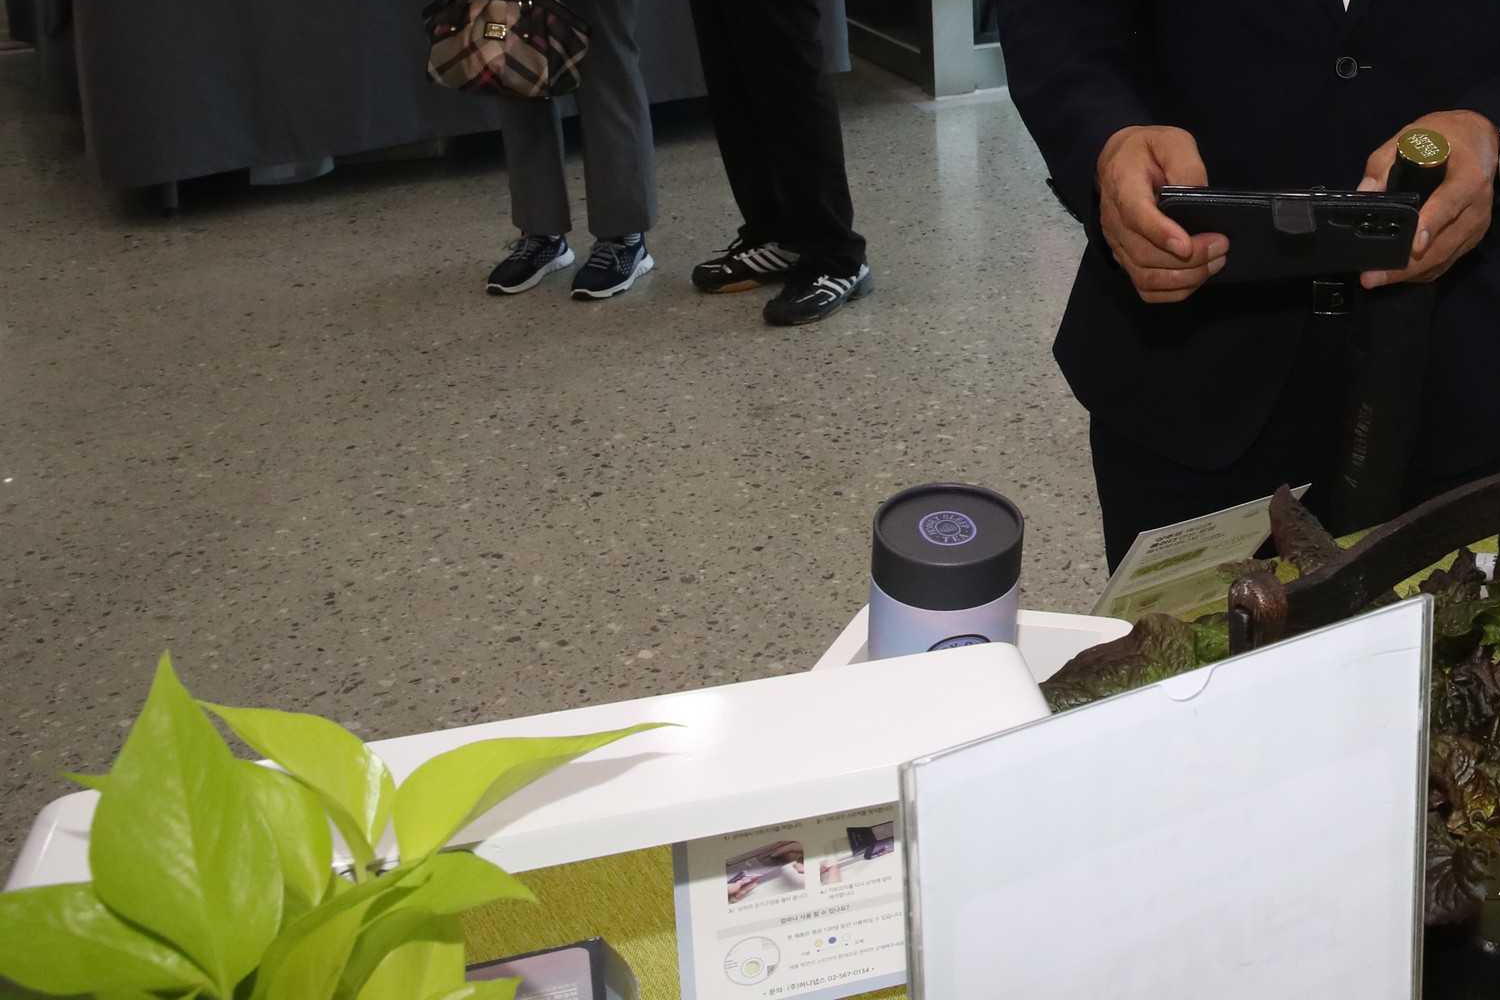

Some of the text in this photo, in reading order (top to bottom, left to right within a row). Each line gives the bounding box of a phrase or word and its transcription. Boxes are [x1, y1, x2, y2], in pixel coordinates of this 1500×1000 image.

[942, 514, 970, 529] SLEEP
[800, 912, 812, 920] 사용
[787, 977, 825, 991] (주)허니냅스
[827, 967, 870, 983] 02-567-0134
